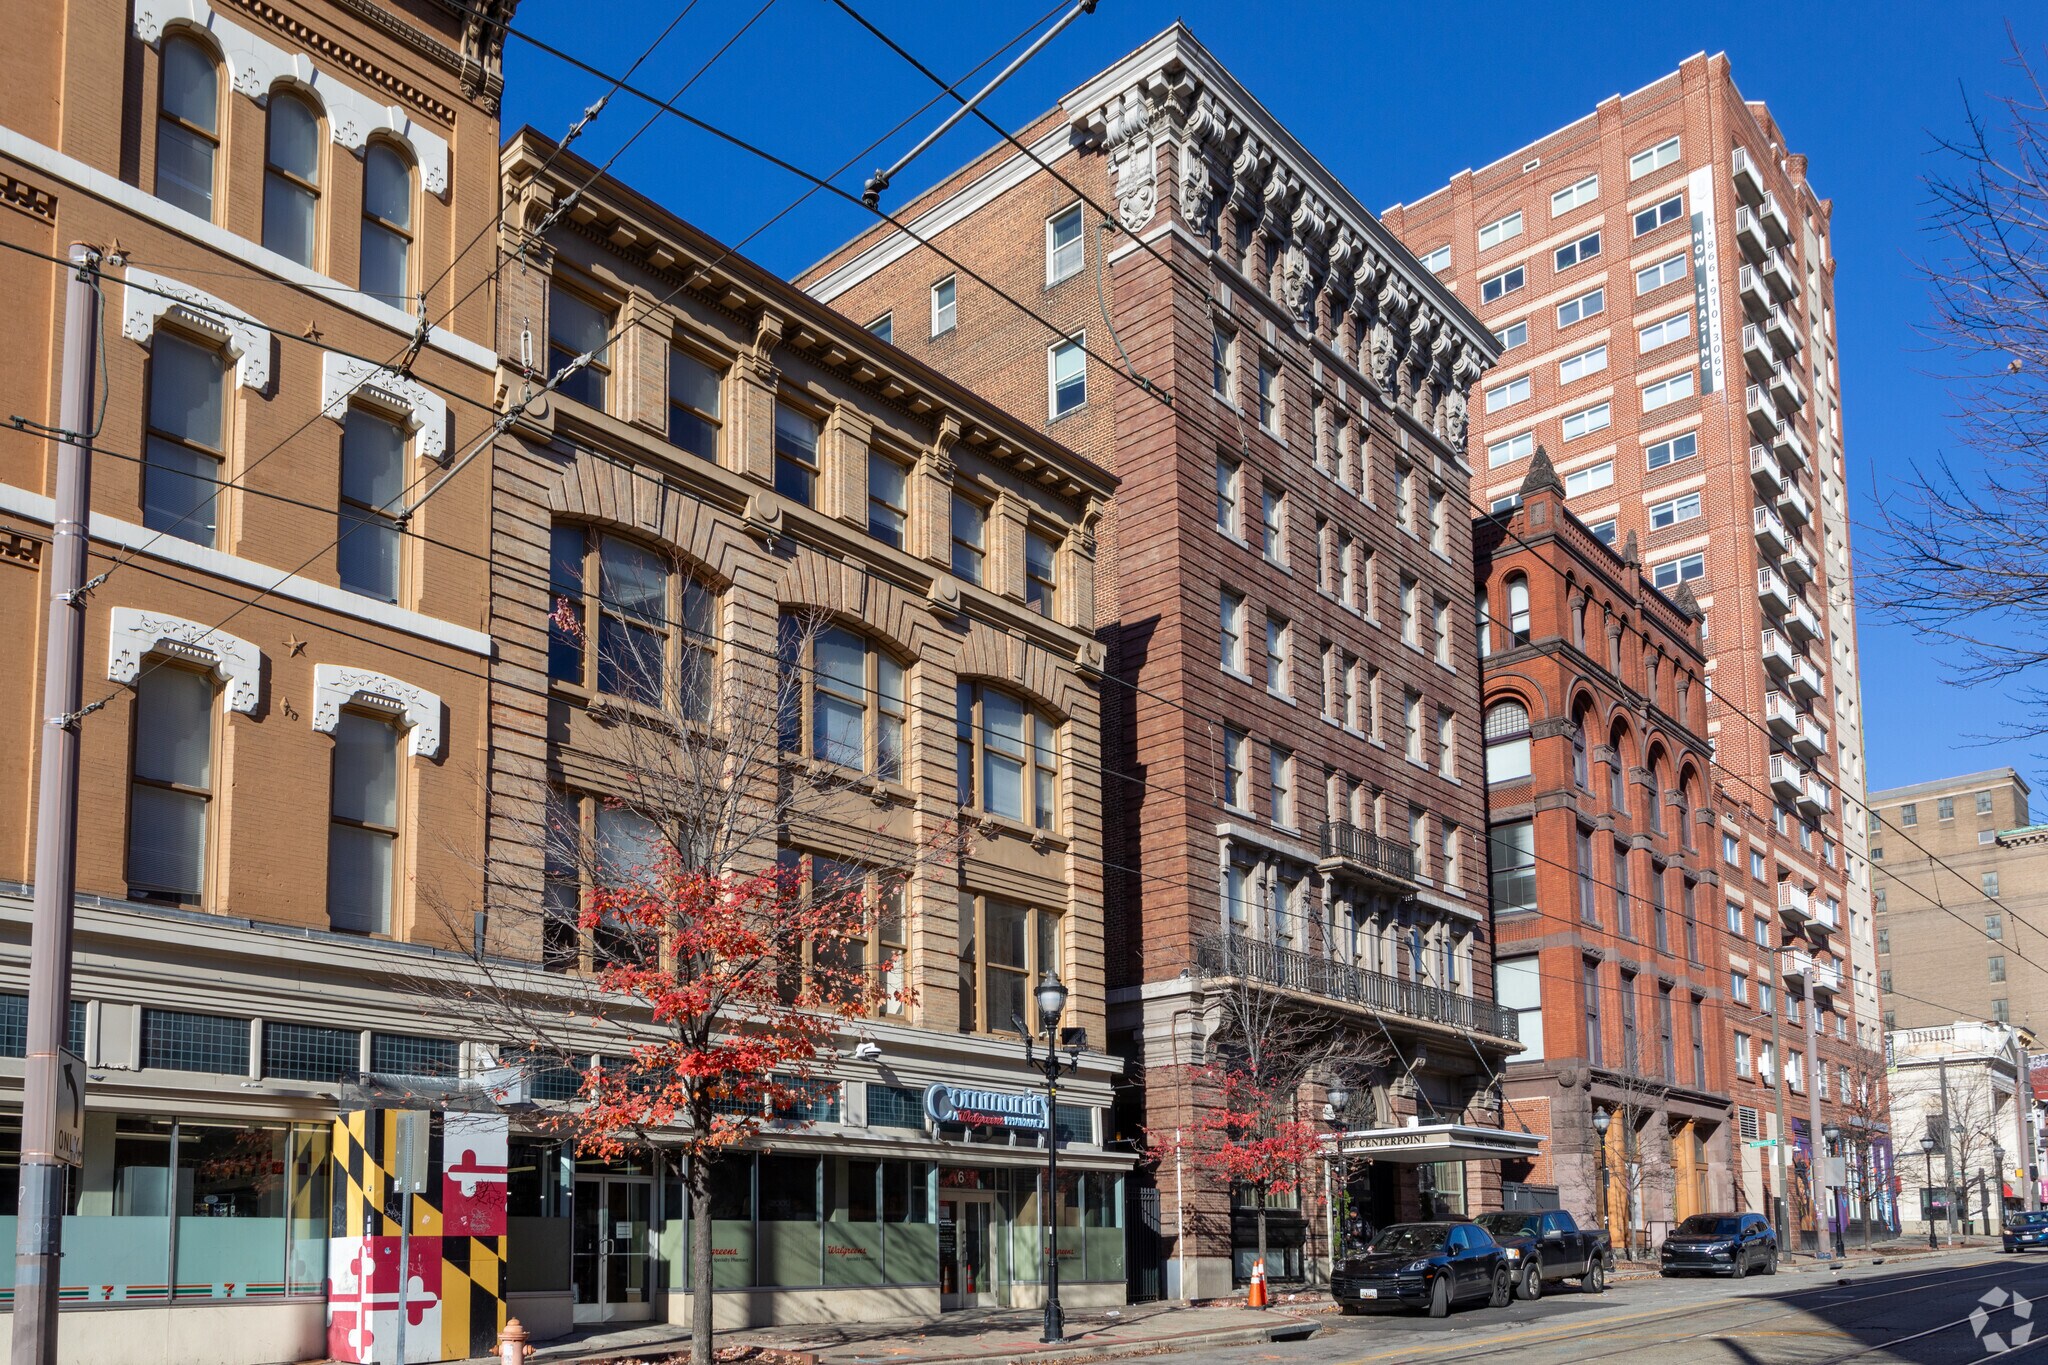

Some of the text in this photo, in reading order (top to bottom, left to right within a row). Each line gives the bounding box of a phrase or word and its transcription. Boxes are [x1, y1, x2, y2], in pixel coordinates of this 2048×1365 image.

[1693, 230, 1711, 370] NOW LEASING
[924, 1082, 1050, 1129] Community
[957, 1109, 1004, 1129] Walgreens
[58, 1129, 80, 1154] ONLY
[1359, 1135, 1428, 1148] CENTERPOINT
[957, 1170, 965, 1184] 6
[827, 1244, 867, 1257] Walgreens
